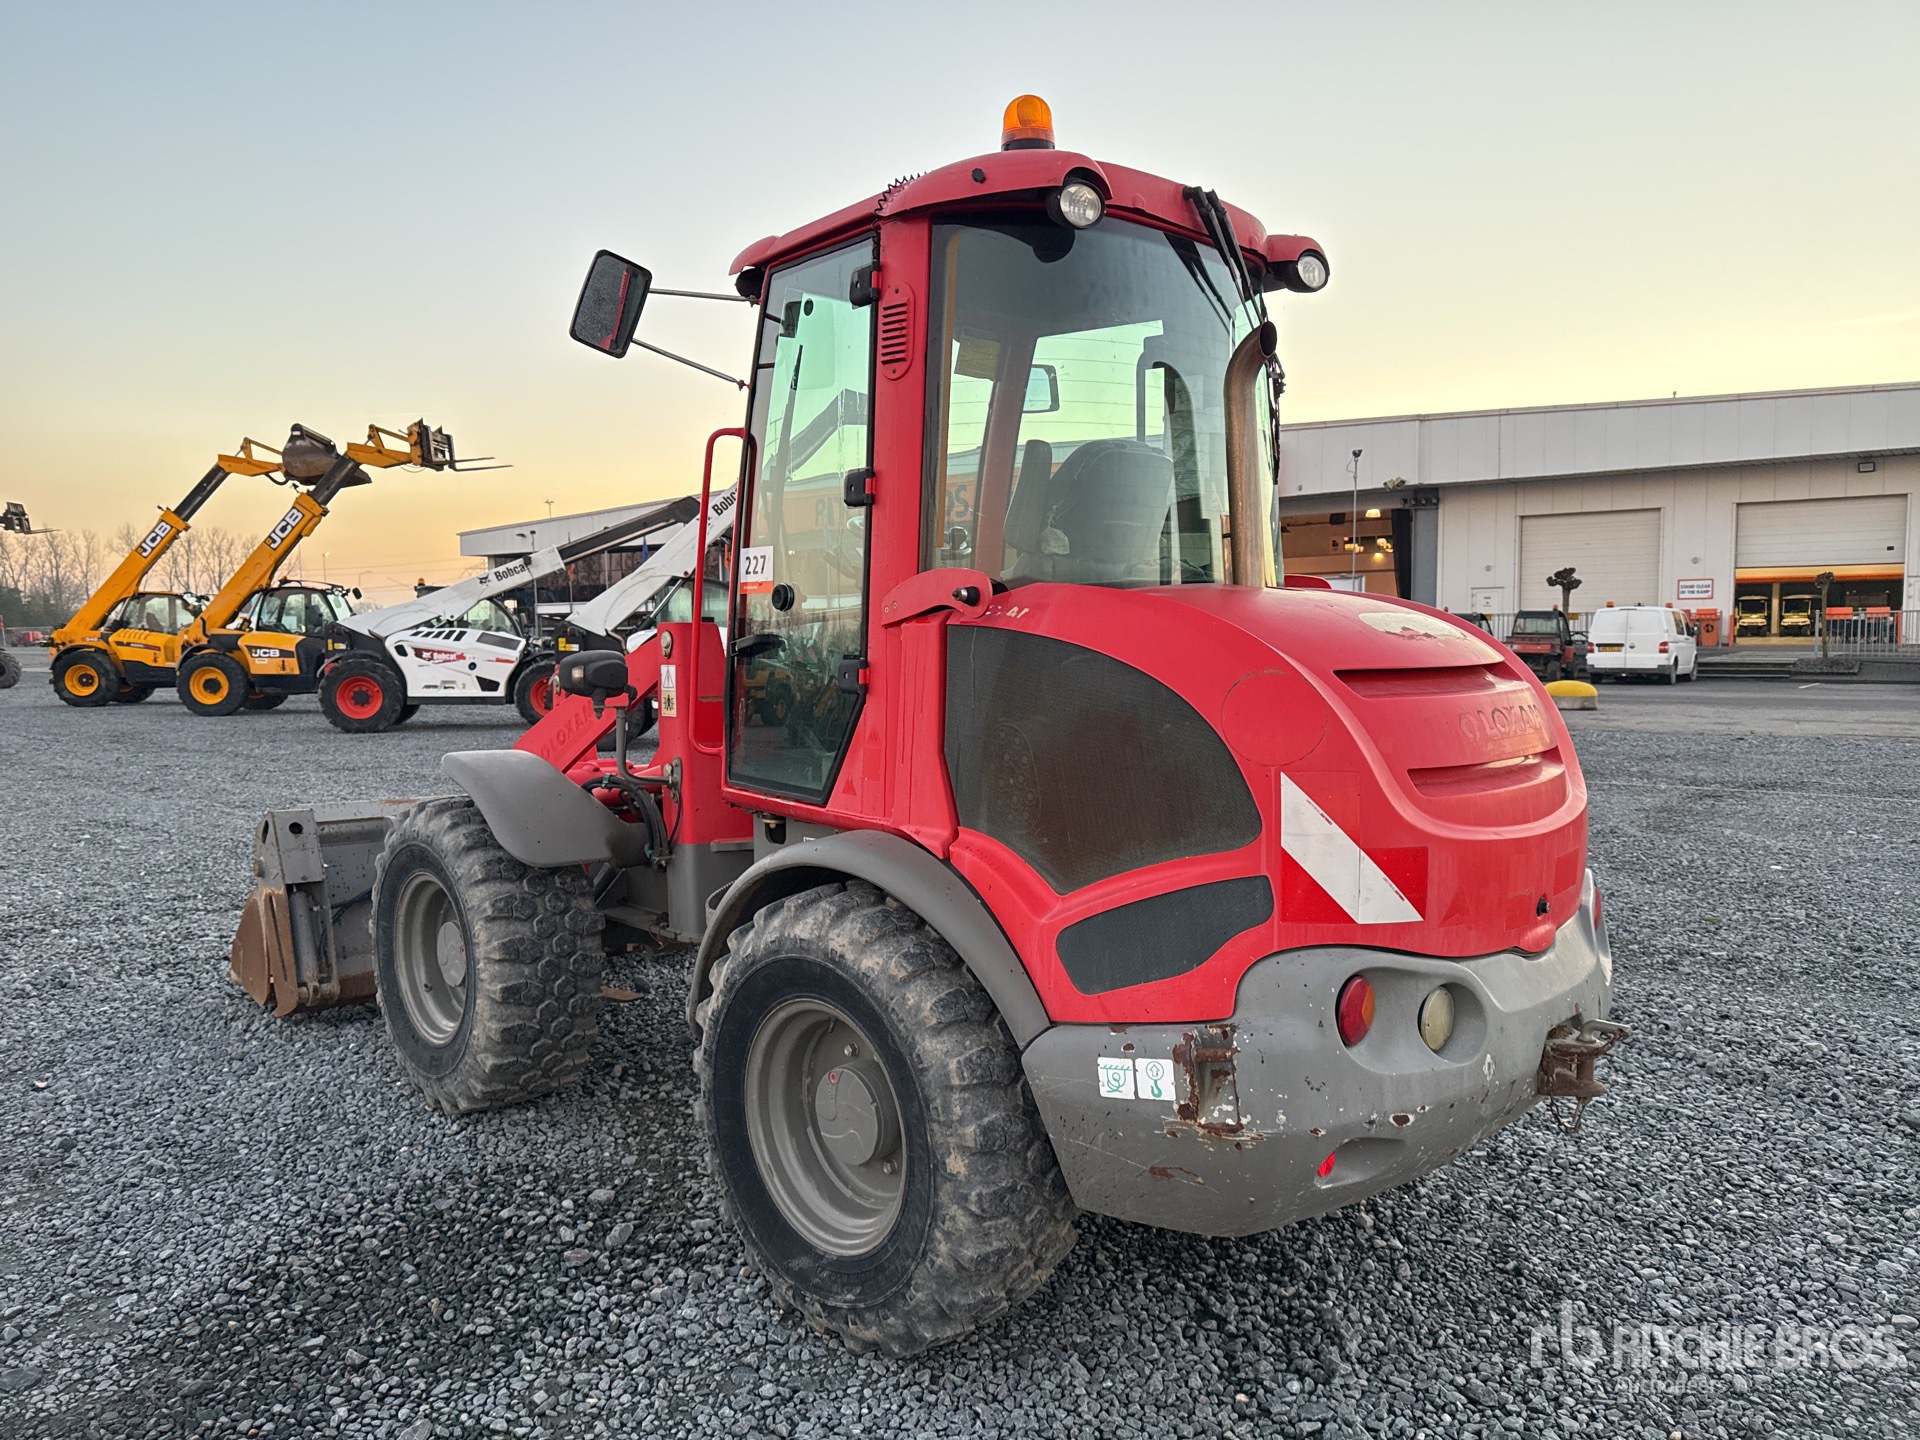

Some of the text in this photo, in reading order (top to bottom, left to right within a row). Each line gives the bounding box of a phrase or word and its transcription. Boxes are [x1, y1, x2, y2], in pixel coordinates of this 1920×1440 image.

[711, 487, 737, 516] Bobc
[269, 507, 303, 549] JCB
[140, 521, 172, 557] JCB
[493, 563, 529, 581] Bobca
[745, 554, 766, 575] 227
[251, 648, 280, 657] JCB
[433, 652, 457, 660] Bobcat
